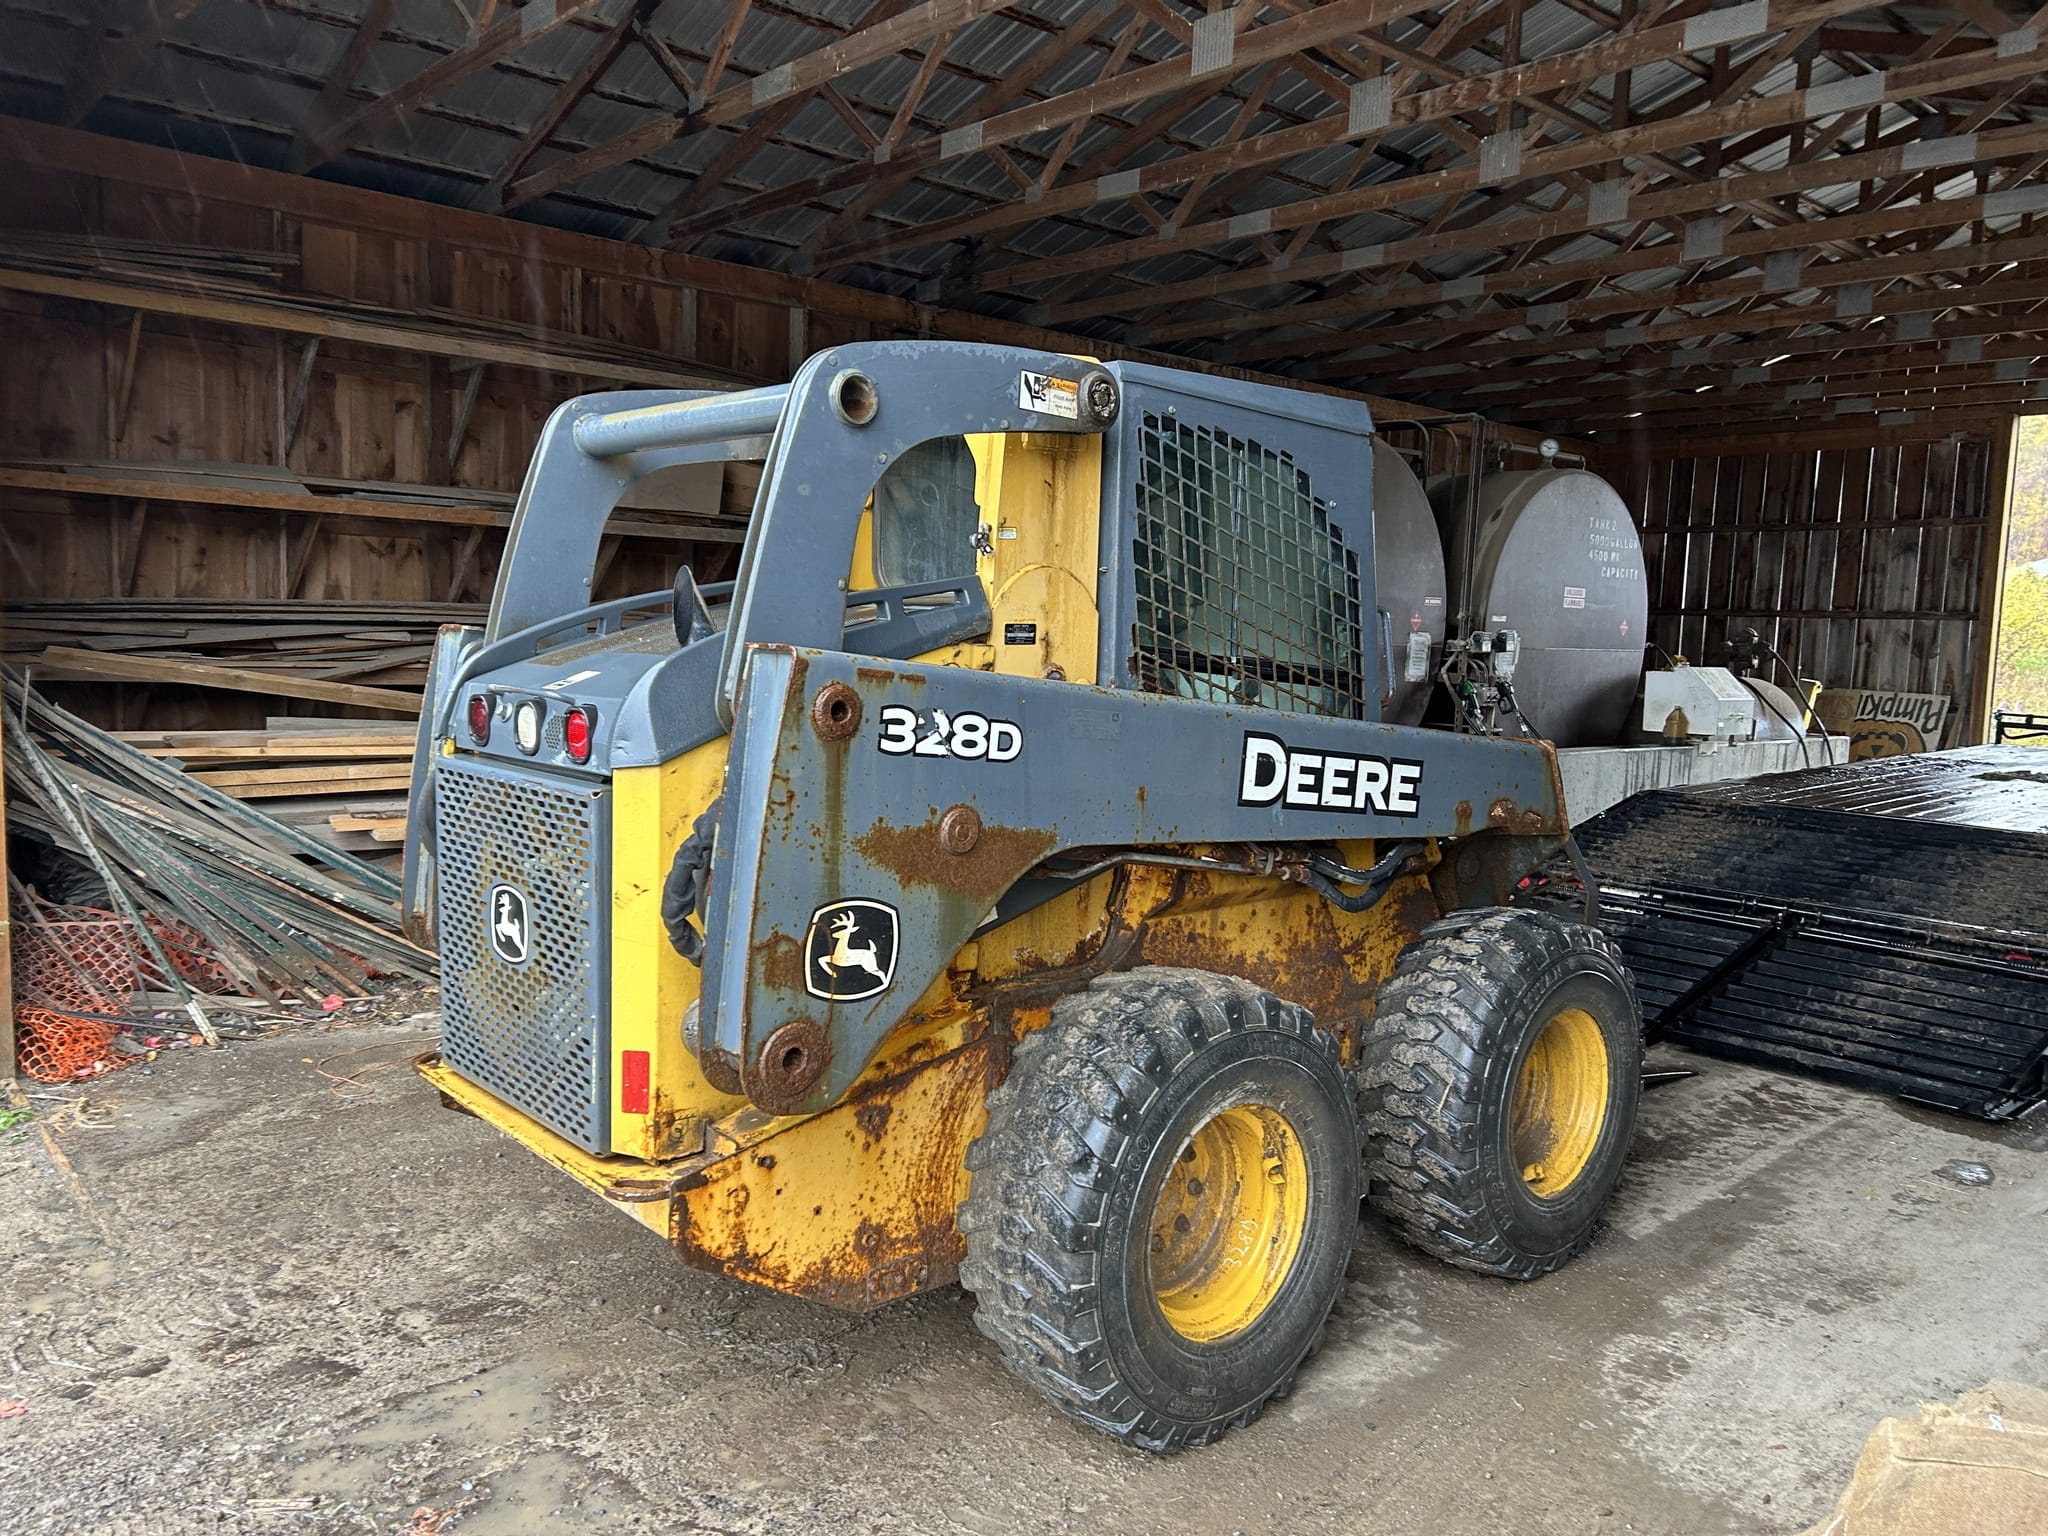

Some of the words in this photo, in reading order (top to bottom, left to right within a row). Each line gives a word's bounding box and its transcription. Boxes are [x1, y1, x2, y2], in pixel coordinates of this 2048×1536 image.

[1589, 517, 1610, 531] TANK
[1588, 549, 1608, 562] 4500
[1601, 566, 1638, 580] CAPACITY
[879, 705, 1023, 763] 328D
[1239, 731, 1423, 817] DEERE
